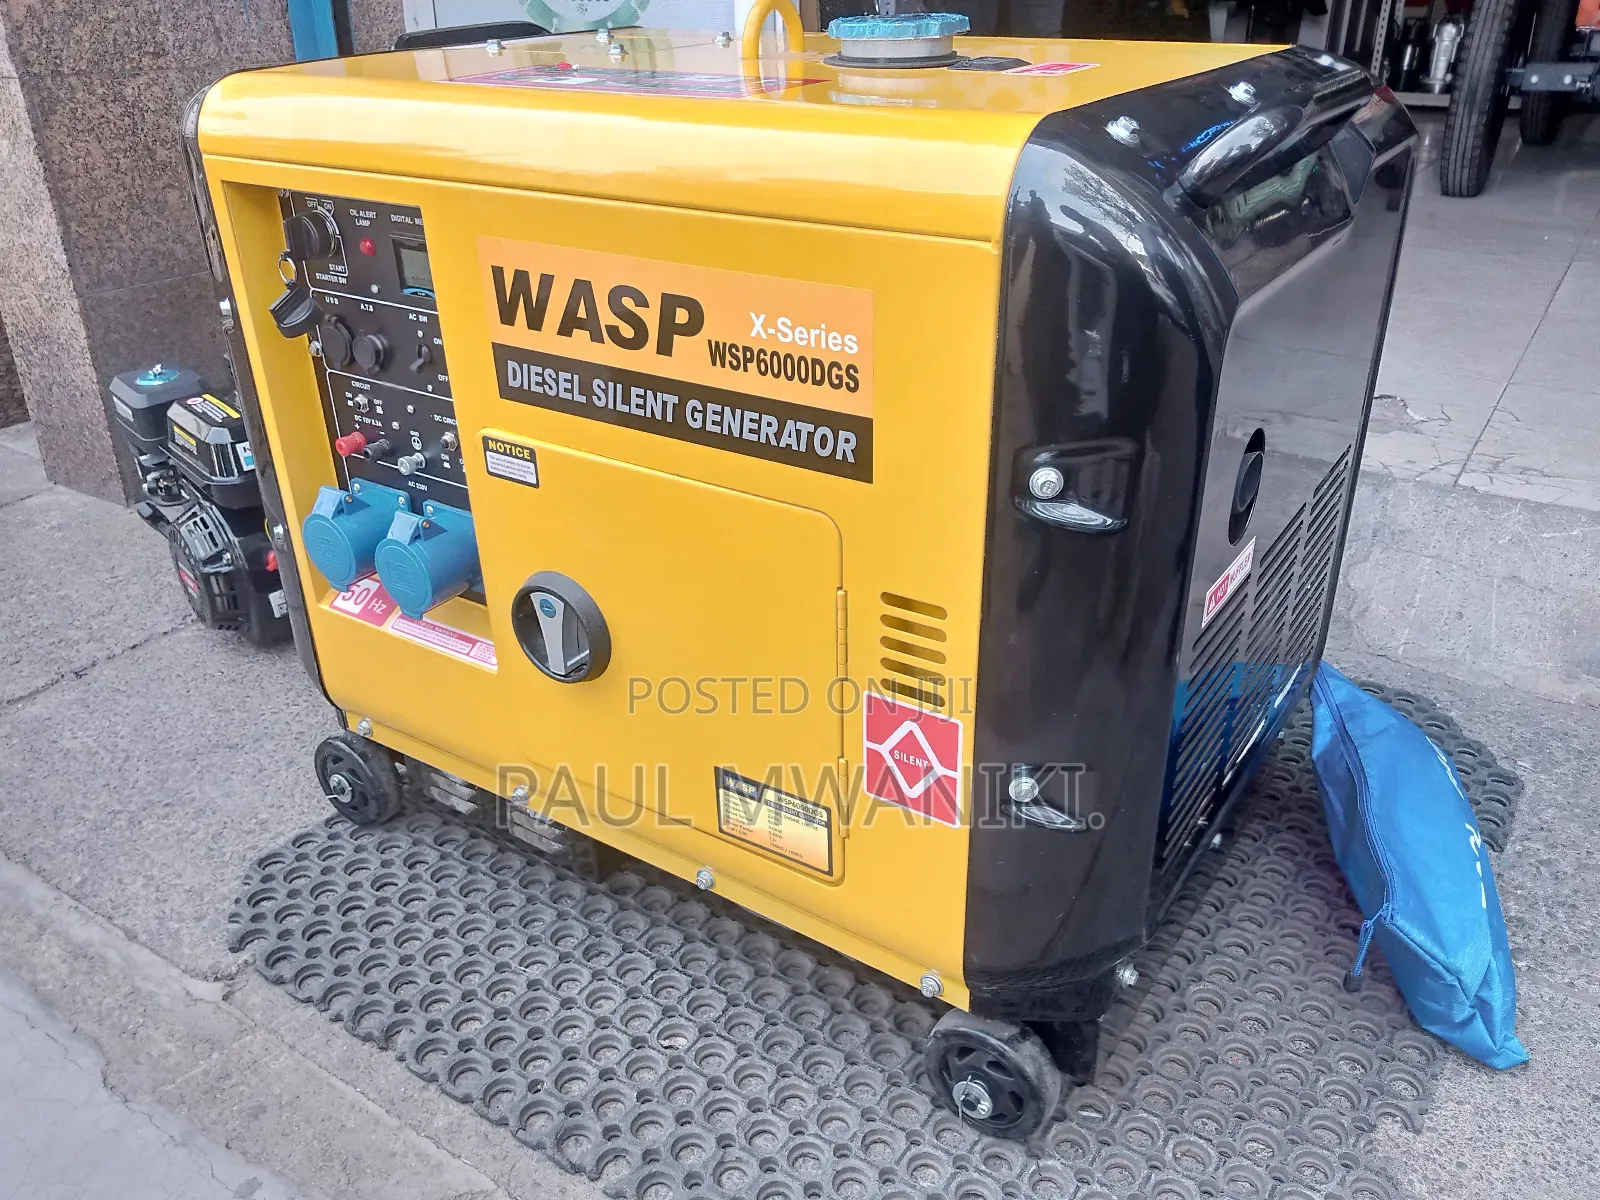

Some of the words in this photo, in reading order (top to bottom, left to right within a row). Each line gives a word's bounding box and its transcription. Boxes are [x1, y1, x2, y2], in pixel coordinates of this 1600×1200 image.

[350, 208, 359, 216] OIL
[360, 210, 376, 218] ALERT
[391, 214, 413, 224] DIGITAL
[356, 219, 370, 227] LAMP
[329, 264, 345, 272] START
[316, 273, 338, 284] STARTER
[491, 264, 705, 357] WASP
[749, 311, 858, 354] X-Series
[707, 338, 860, 394] WSP6000DGS
[352, 380, 370, 390] CIRCUIT
[438, 374, 448, 382] OFF
[506, 359, 586, 404] DIESEL
[592, 378, 679, 424] SILENT
[686, 398, 857, 464] GENERATOR
[488, 440, 530, 460] NOTICE
[342, 584, 370, 606] 50
[368, 598, 387, 614] Hz
[893, 749, 929, 770] SILENT
[724, 776, 756, 794] WASP
[778, 795, 824, 818] WSP6000DGS
